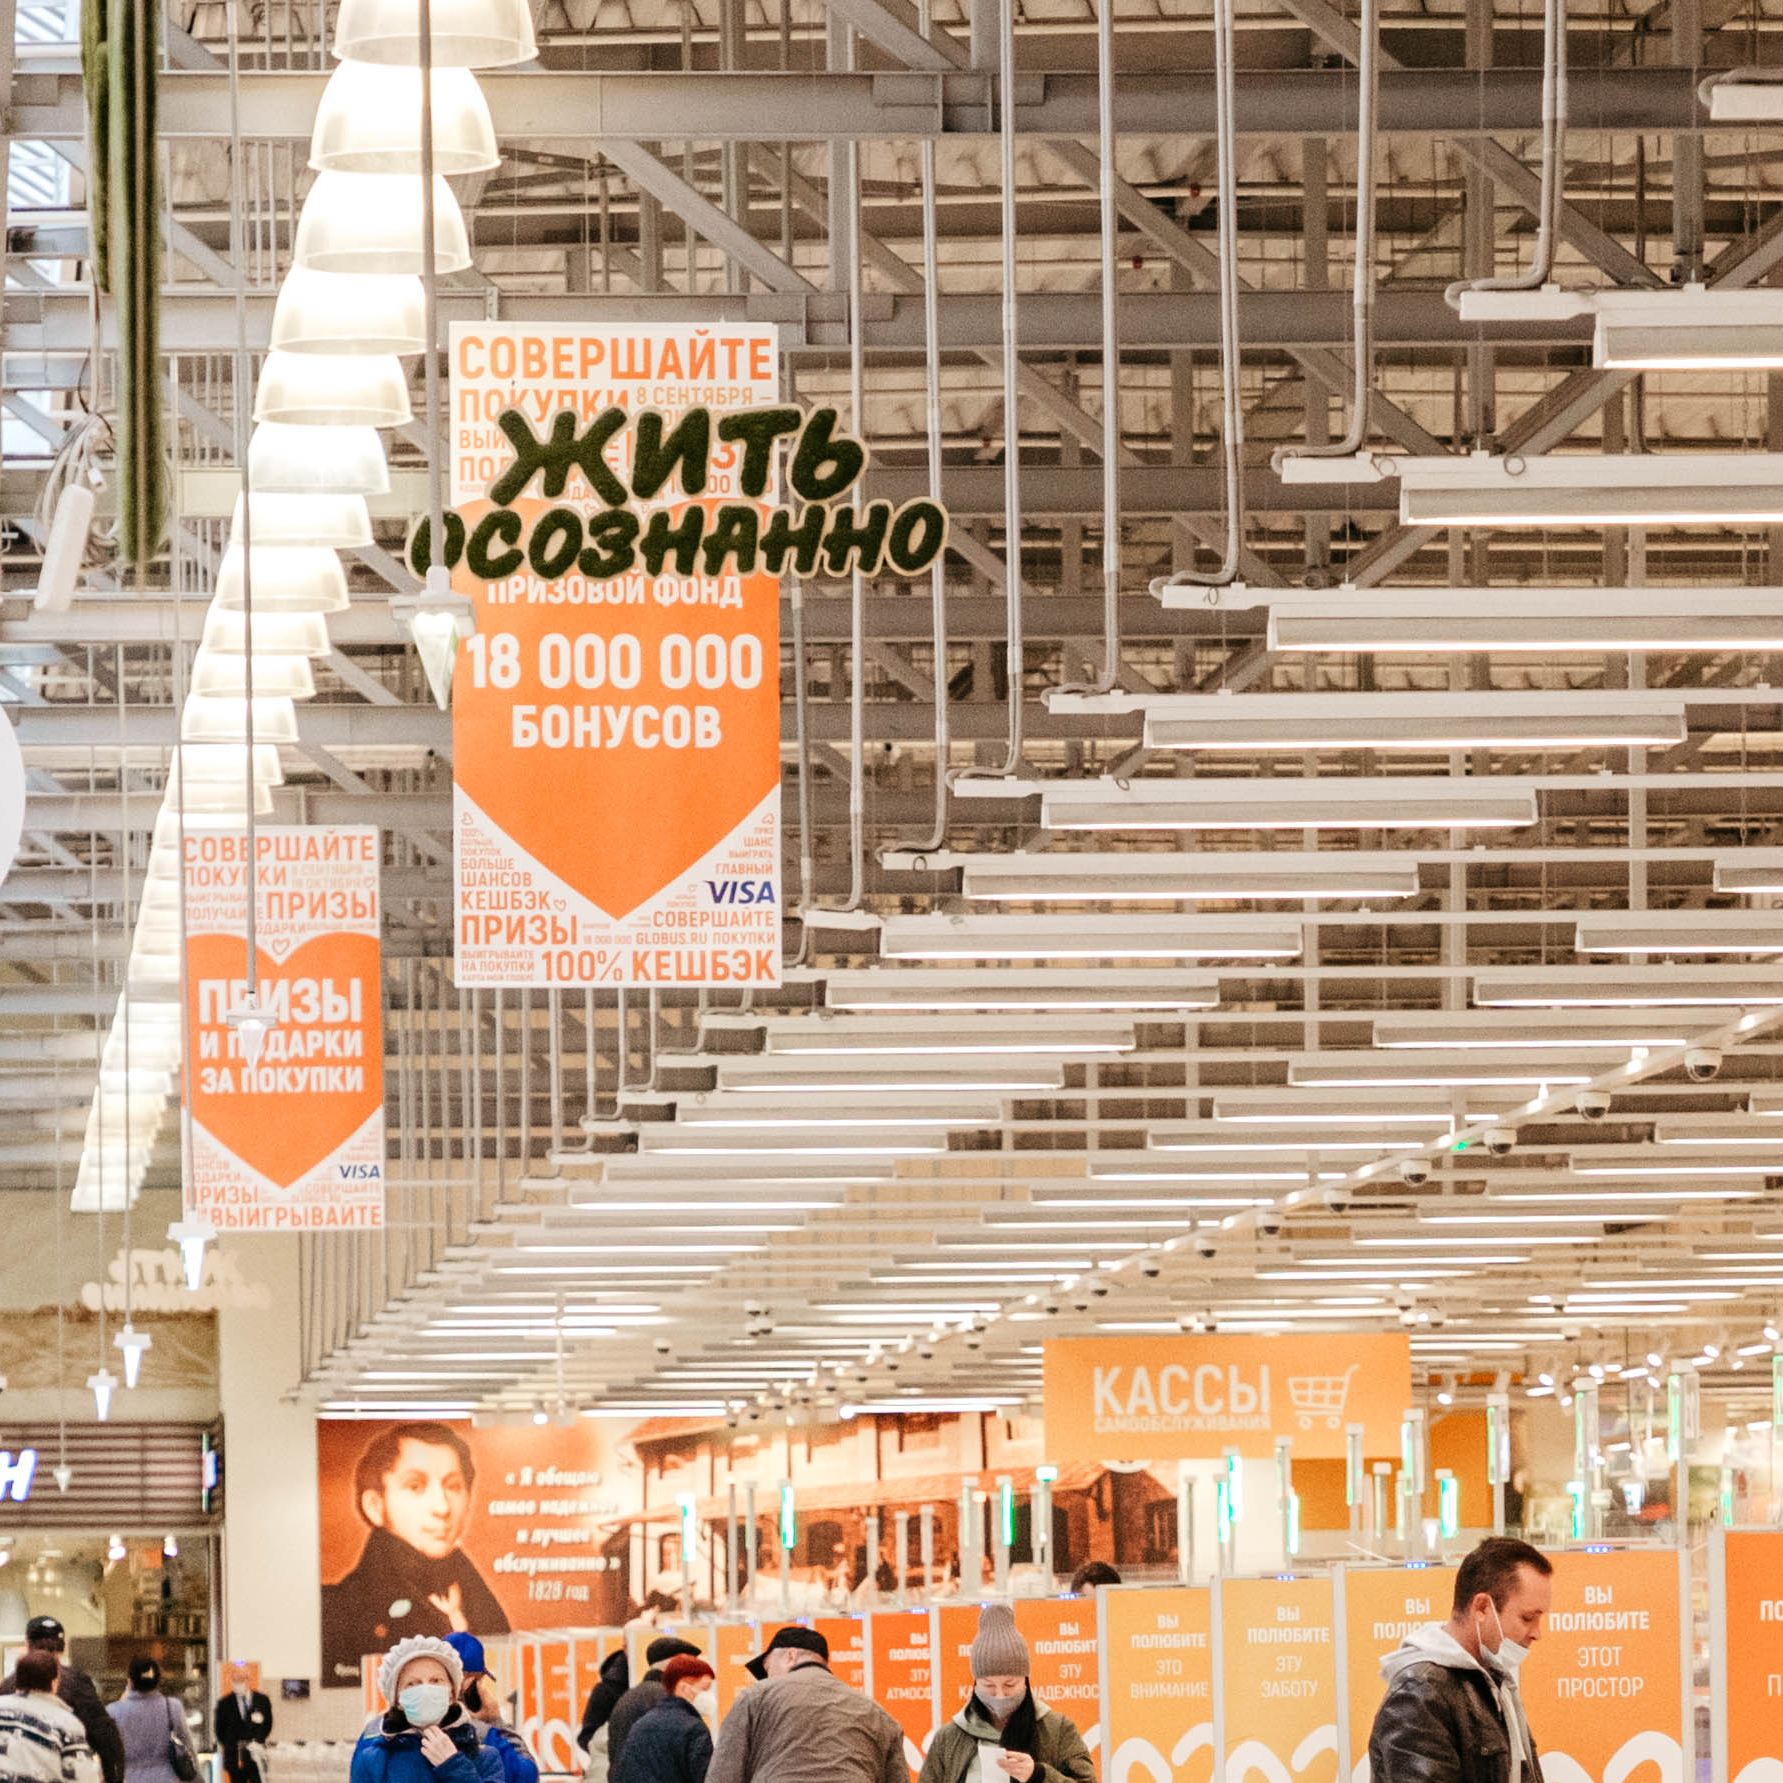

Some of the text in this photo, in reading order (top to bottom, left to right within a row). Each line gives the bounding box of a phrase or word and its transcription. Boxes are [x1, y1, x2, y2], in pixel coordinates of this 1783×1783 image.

[458, 329, 772, 380] СОВЕРШАЙТЕ
[652, 386, 754, 405] СЕНТЯБРЯ
[490, 407, 865, 507] ЖИТЬ
[409, 502, 946, 578] ОСОЗНАННО
[465, 633, 763, 690] 18 000 000
[511, 704, 722, 749] БОНУСОВ
[461, 858, 515, 870] БОЛЬШЕ
[715, 860, 773, 875] ГЛАВНЫЙ
[461, 871, 533, 887] ШАНСОВ
[461, 890, 551, 911] КЕШБЭК
[704, 880, 776, 904] VISA
[266, 890, 377, 920] ПРИЗЫ
[653, 906, 775, 928] СОВЕРШАЙТЕ
[461, 914, 578, 945] ПРИЗЫ
[712, 932, 776, 945] ПОКУПКИ
[480, 961, 535, 972] ПОКУПКИ
[541, 949, 776, 982] 100% КЕШБЭК
[199, 1030, 218, 1059] И
[200, 1066, 364, 1094] ЗА ПОКУПКИ
[339, 1164, 381, 1179] VISA
[210, 1205, 382, 1228] ВЫИГРЫВАЙТЕ
[1093, 1364, 1271, 1415] КАССЫ
[1093, 1412, 1272, 1434] САМООБСЛУЖИВАНИЯ
[1584, 1585, 1613, 1605] ВЫ
[1276, 1606, 1300, 1623] ВЫ
[1405, 1598, 1431, 1615] ВЫ
[1157, 1614, 1179, 1630] ВЫ
[1549, 1609, 1651, 1632] ПОЛЮБИТЕ
[1131, 1631, 1207, 1650] ПОЛЮБИТЕ
[1247, 1624, 1330, 1645] ПОЛЮБИТЕ
[1275, 1656, 1303, 1674] ЭТУ
[1577, 1646, 1623, 1668] ЭТОТ
[1155, 1659, 1184, 1677] ЭТО
[1129, 1680, 1209, 1699] ВНИМАНИЕ
[1260, 1680, 1320, 1700] ЗАБОТУ
[1557, 1676, 1645, 1699] ПРОСТОР
